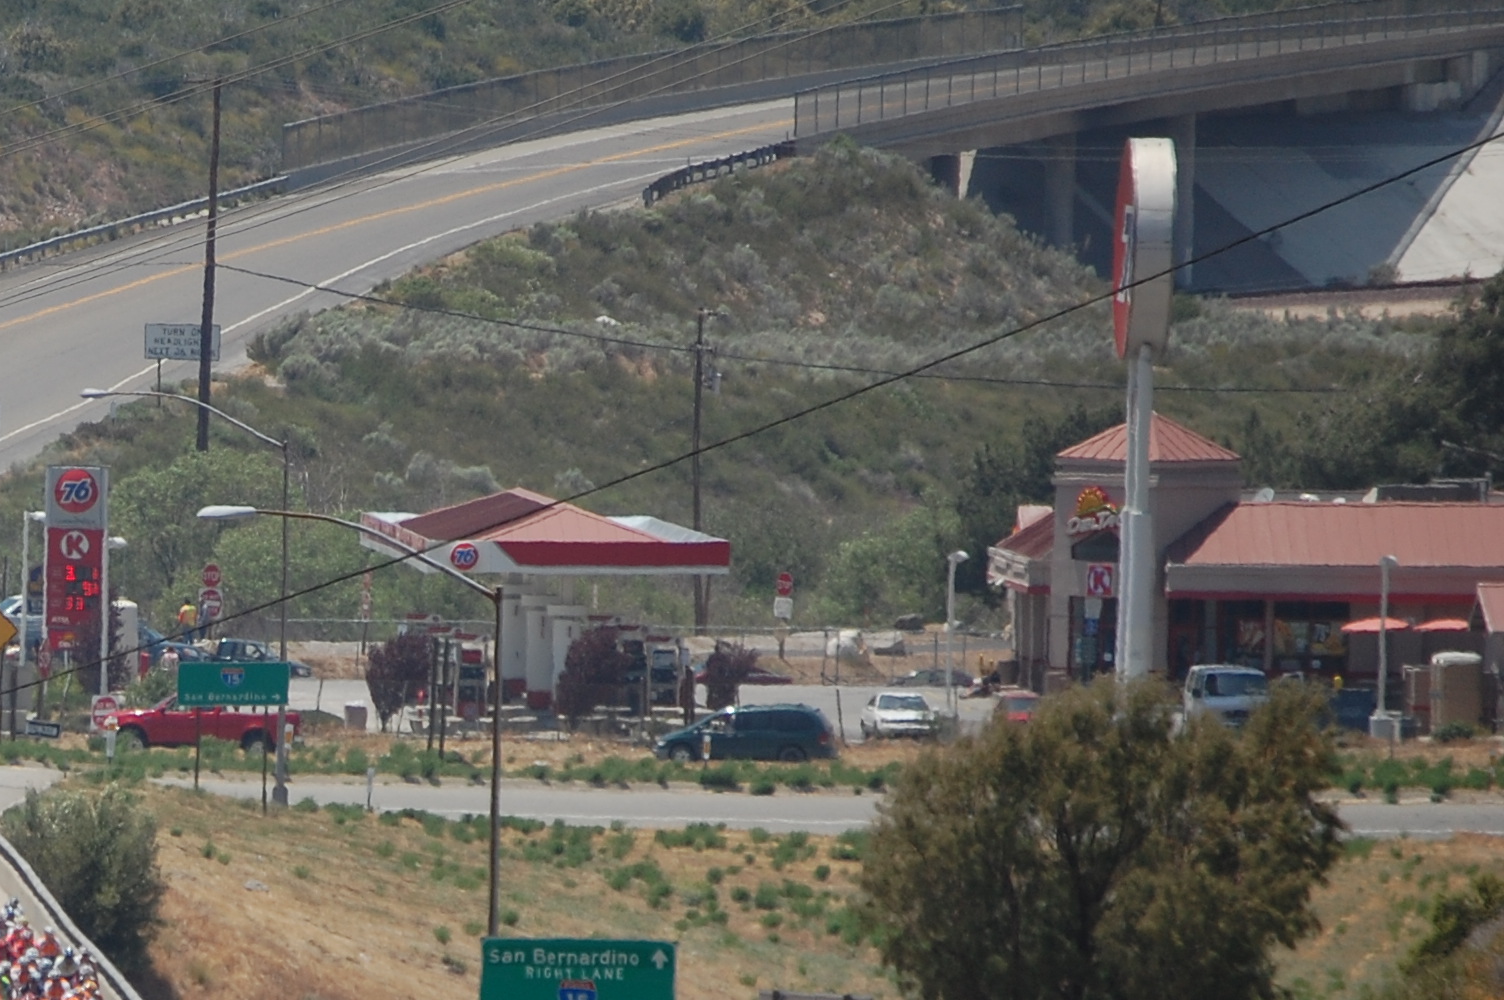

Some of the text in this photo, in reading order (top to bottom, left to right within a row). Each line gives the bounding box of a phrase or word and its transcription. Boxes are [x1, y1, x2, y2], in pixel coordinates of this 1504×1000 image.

[162, 327, 185, 336] TURN
[148, 347, 170, 356] NEXT
[60, 478, 93, 505] 76
[62, 533, 89, 559] K
[455, 548, 476, 565] 76
[228, 674, 240, 684] 15
[208, 692, 267, 700] Bernardino
[489, 948, 639, 966] San Bernardino
[525, 967, 624, 980] RIGHT LANE
